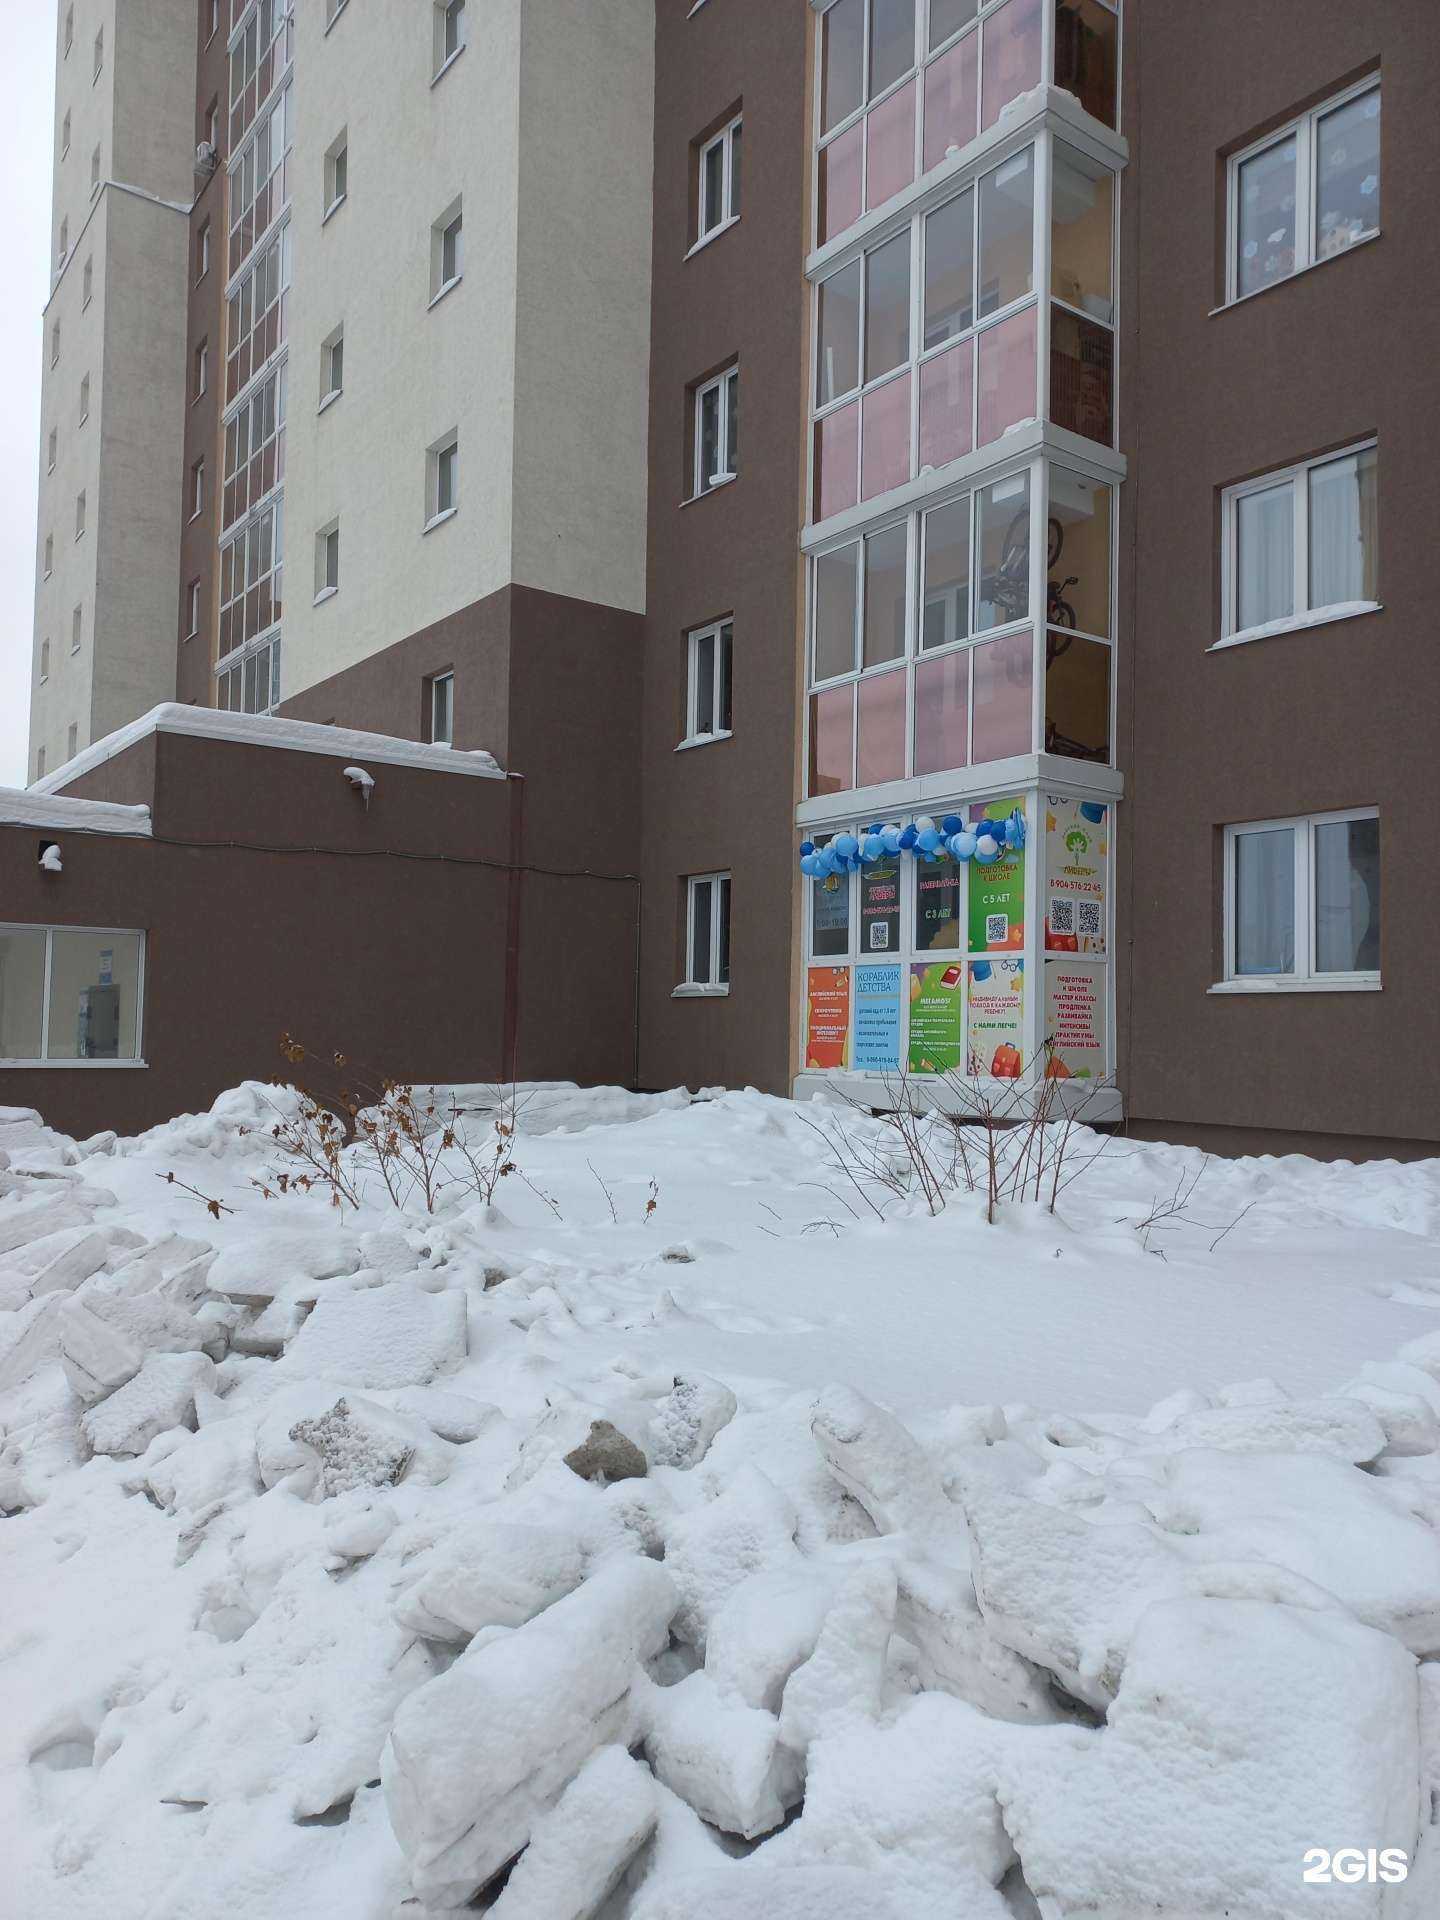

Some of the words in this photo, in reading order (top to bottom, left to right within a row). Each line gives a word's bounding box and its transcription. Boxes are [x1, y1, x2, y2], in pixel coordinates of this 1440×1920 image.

[988, 872, 1011, 882] ШКОЛЕ
[982, 895, 989, 904] С
[989, 894, 996, 904] 5
[996, 893, 1011, 903] ЛЕТ
[857, 971, 899, 982] КОРАБЛИК
[1057, 976, 1093, 984] ПОДГОТОВКА
[857, 982, 891, 993] ДЕТСТВА
[1053, 993, 1074, 1001] МАСТЕР
[1074, 994, 1097, 1002] КЛАССЫ
